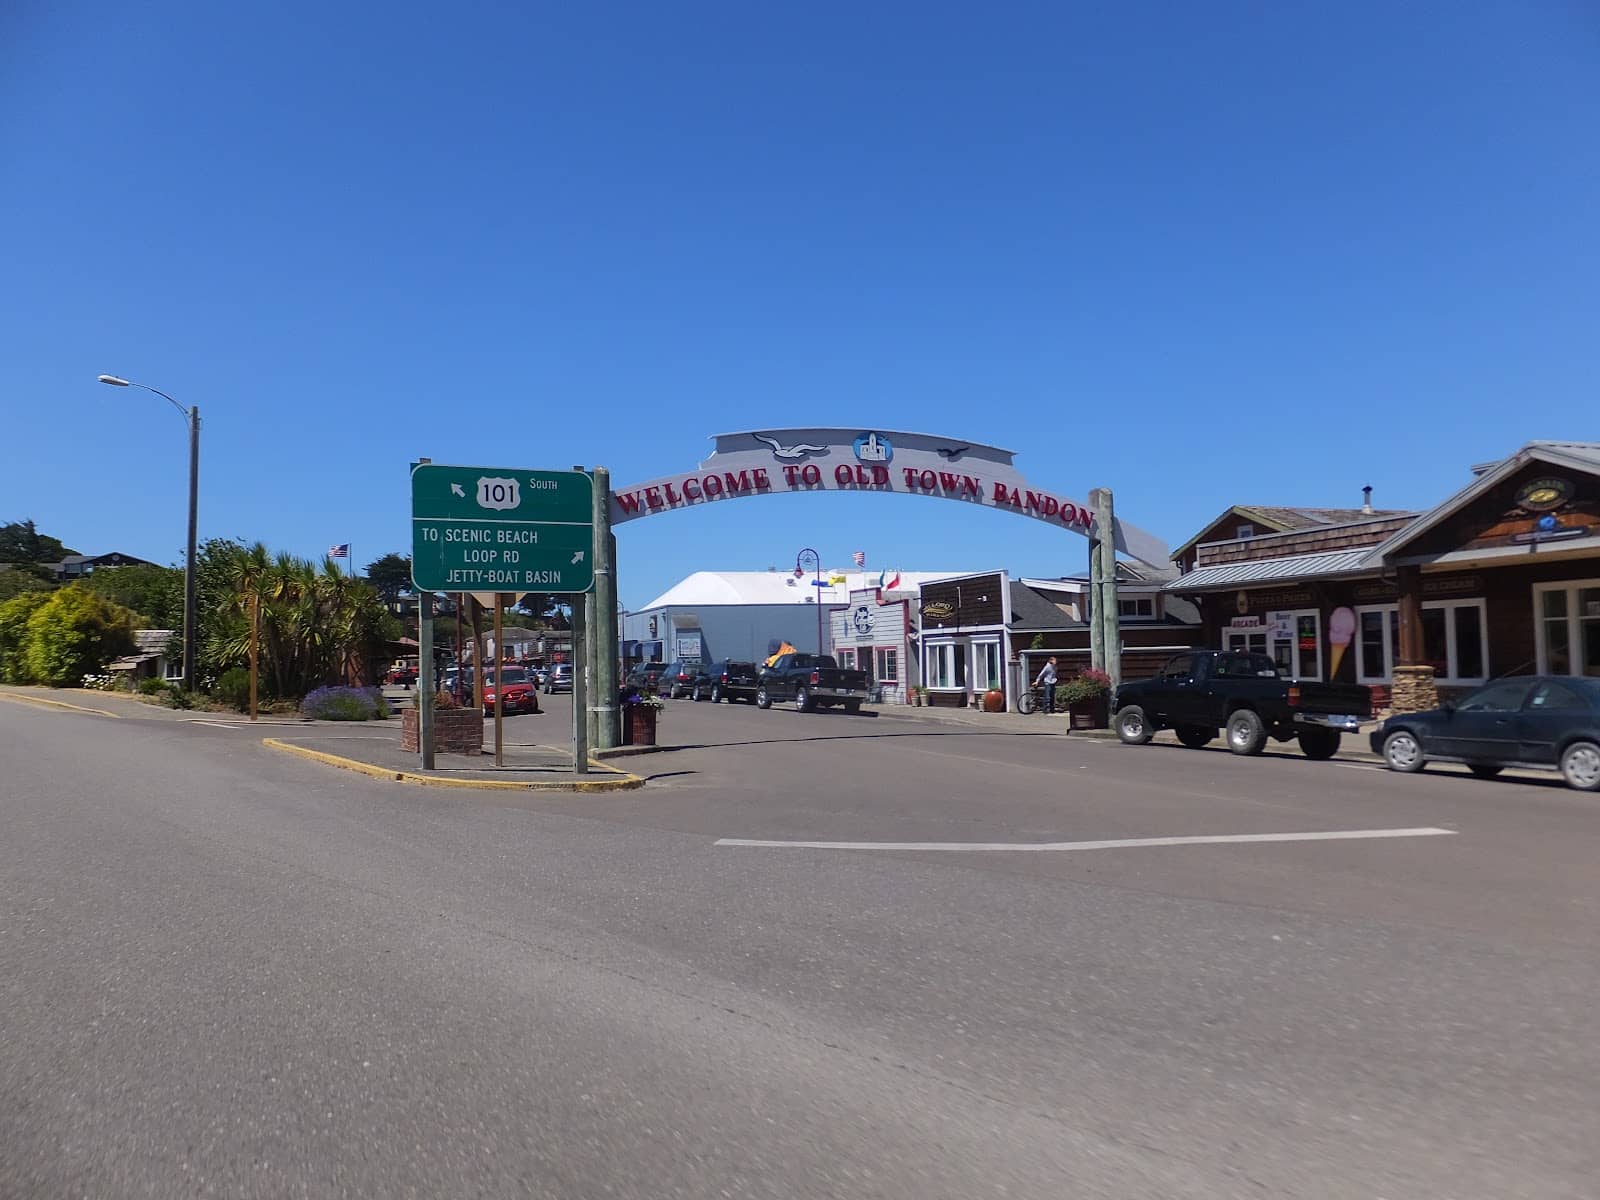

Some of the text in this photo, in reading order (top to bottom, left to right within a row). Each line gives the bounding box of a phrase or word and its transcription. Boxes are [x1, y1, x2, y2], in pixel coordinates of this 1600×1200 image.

[483, 484, 515, 503] 101
[616, 464, 1095, 530] WELCOME TO OLD TOWN BANDON
[422, 527, 538, 544] TO SCENIC BEACH
[463, 550, 520, 563] LOOP RD
[446, 569, 561, 584] JETTY-BOAT BASIN
